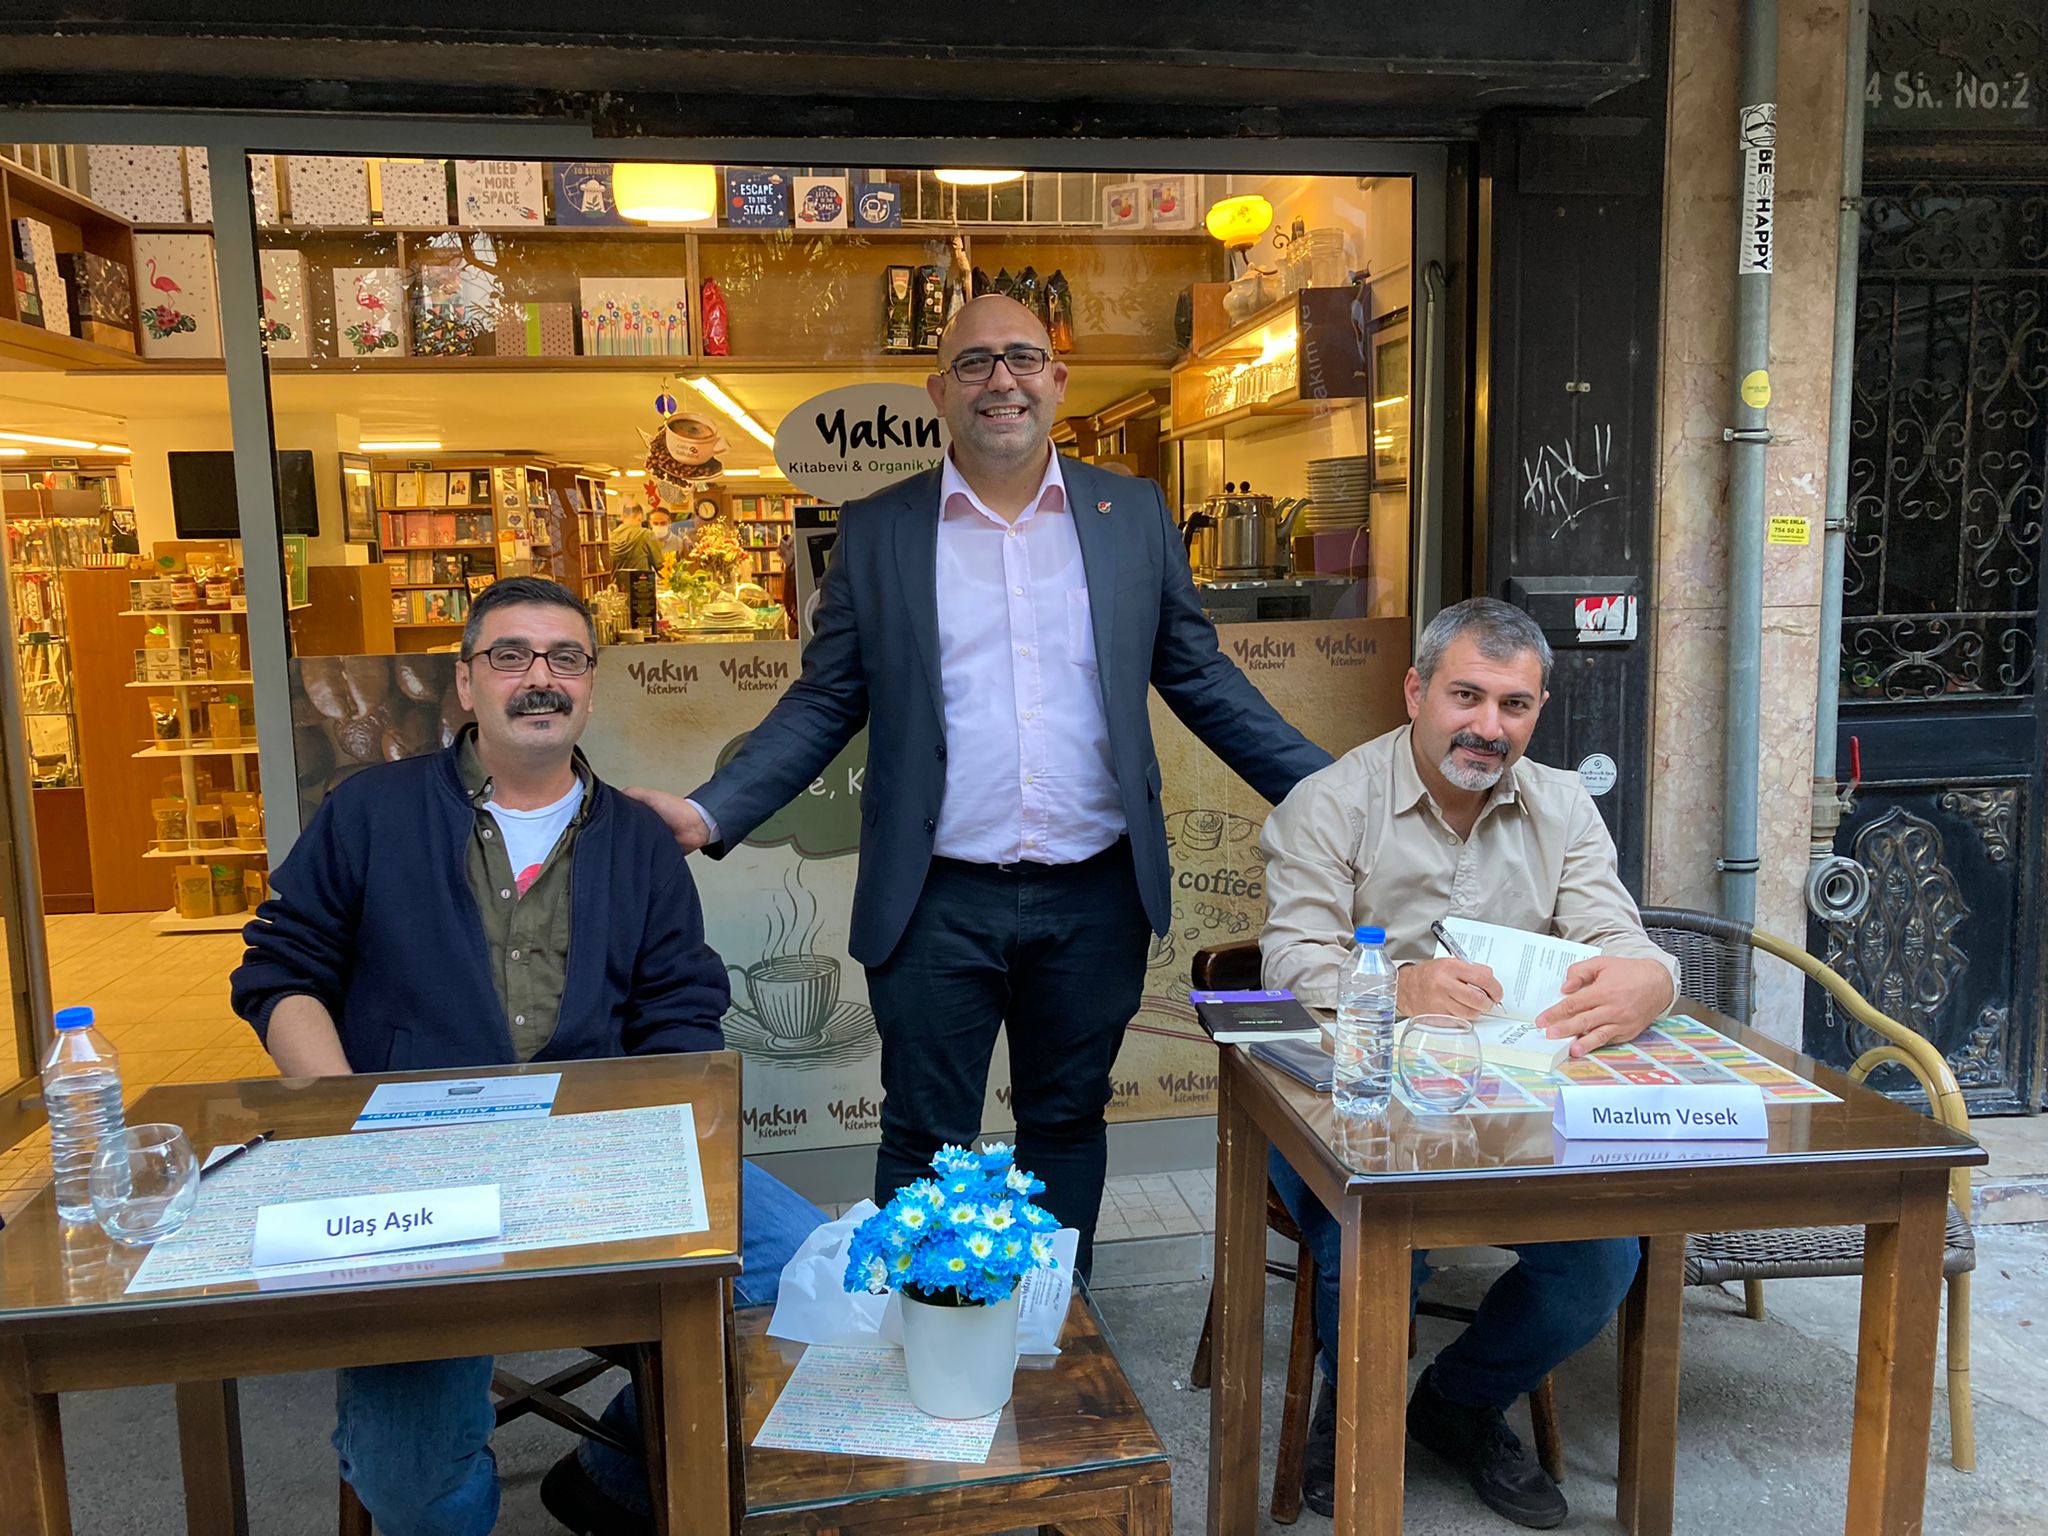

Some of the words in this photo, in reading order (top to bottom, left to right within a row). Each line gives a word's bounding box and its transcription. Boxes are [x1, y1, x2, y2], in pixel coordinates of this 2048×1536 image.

[1955, 71, 2030, 109] No:2
[487, 162, 518, 175] NEED
[1758, 149, 1773, 174] BE
[484, 176, 516, 189] MORE
[740, 183, 774, 195] ESCAPE
[482, 191, 520, 205] SPACE
[743, 205, 774, 215] STARS
[1752, 198, 1771, 271] HAPPY
[789, 460, 848, 473] Kitabevi
[852, 460, 863, 472] &
[868, 458, 924, 475] Organik
[1178, 868, 1262, 899] coffee
[1592, 1106, 1671, 1125] Mazlum
[1676, 1107, 1739, 1125] Vesek
[845, 1120, 881, 1131] kitabev
[325, 1215, 377, 1237] Ulaş
[383, 1207, 434, 1233] Aşık
